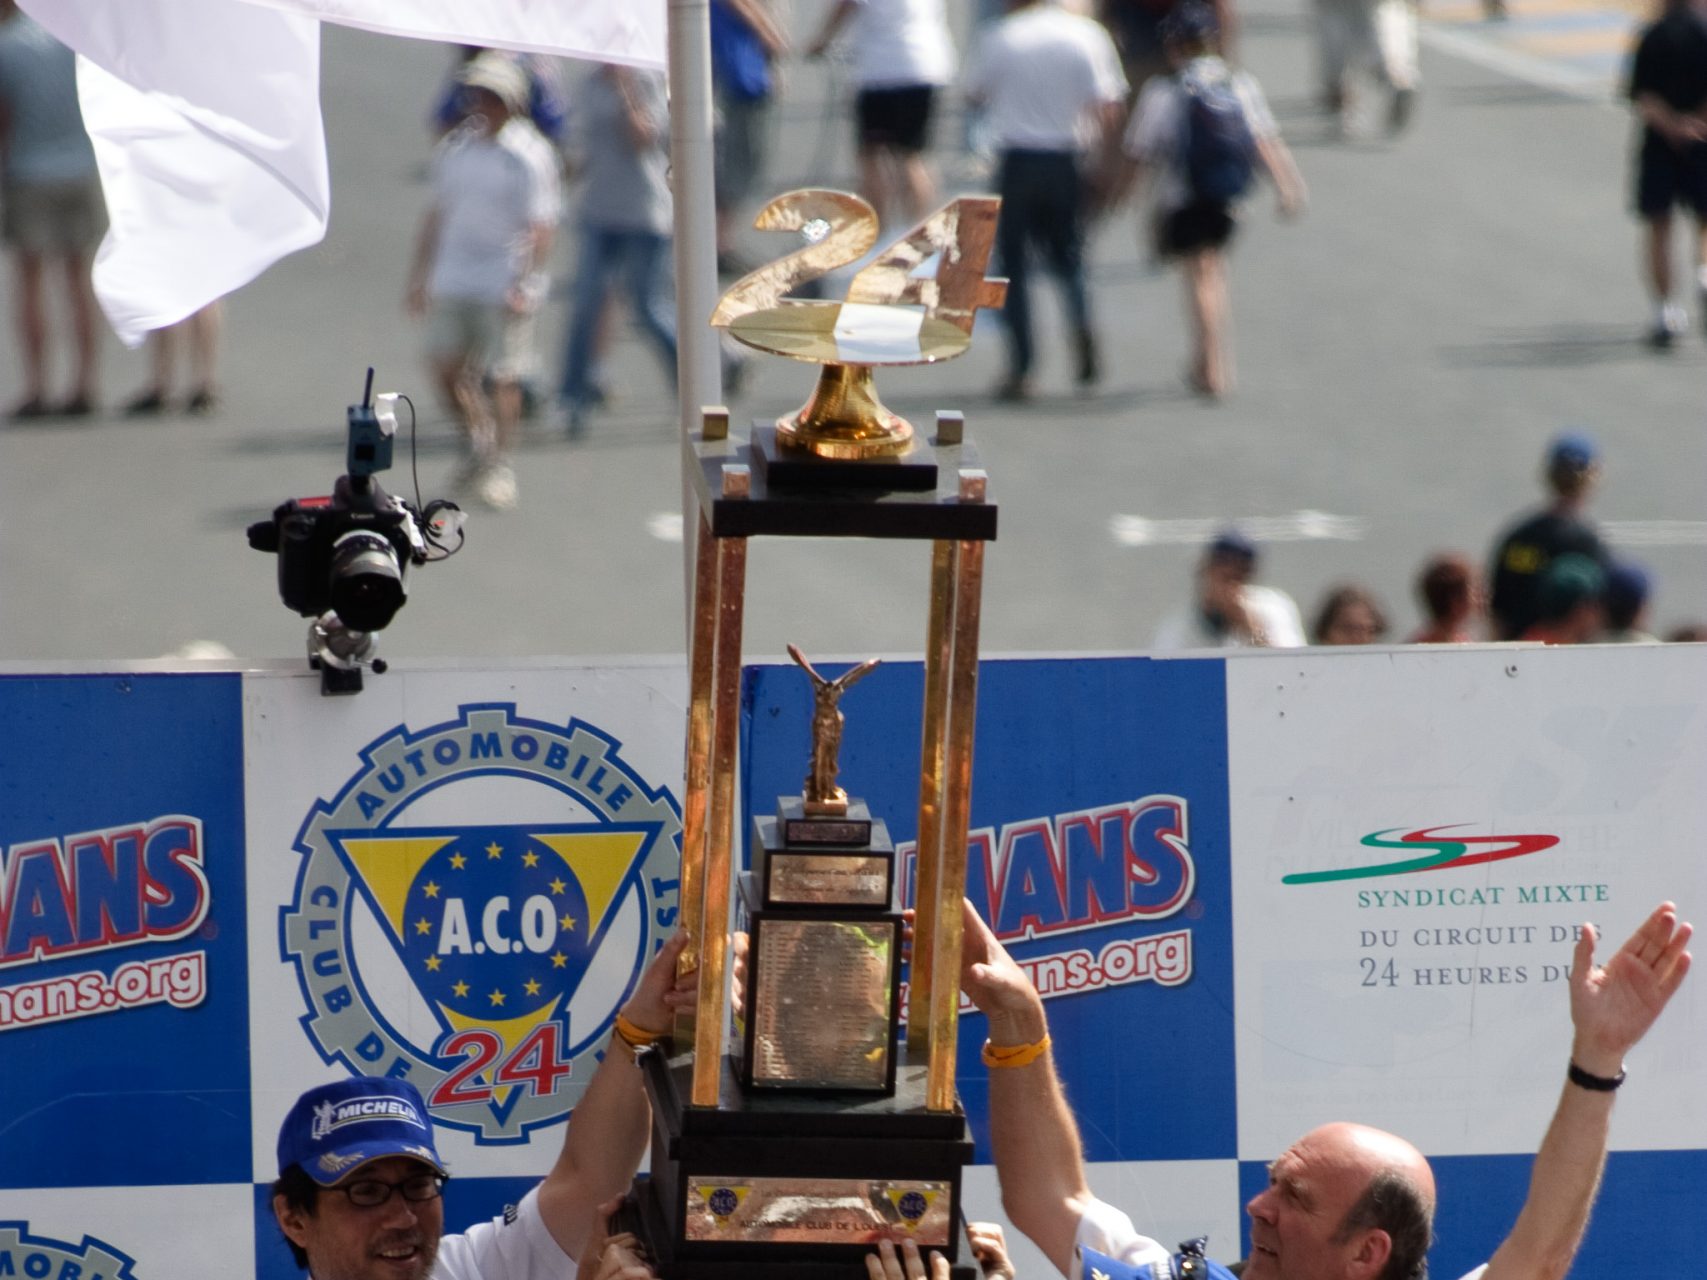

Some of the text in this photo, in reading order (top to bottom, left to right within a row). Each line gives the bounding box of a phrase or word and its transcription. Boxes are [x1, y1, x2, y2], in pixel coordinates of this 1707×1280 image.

[711, 188, 1010, 338] 24
[356, 732, 634, 821] AUTOMOBILE
[0, 814, 210, 969] ANS
[896, 794, 1196, 946] ANS
[1357, 885, 1610, 908] SYNDICAT MIXTE
[308, 885, 353, 1014] CLUB
[437, 894, 559, 955] A.C.O
[1360, 930, 1399, 948] DU
[1413, 926, 1536, 946] CIRCUIT
[1360, 957, 1399, 988] 24
[1414, 966, 1528, 986] HEURES
[428, 1022, 572, 1110] 24
[337, 1101, 418, 1121] MICHELIN
[806, 1222, 832, 1231] CLUB
[834, 1222, 850, 1231] DE
